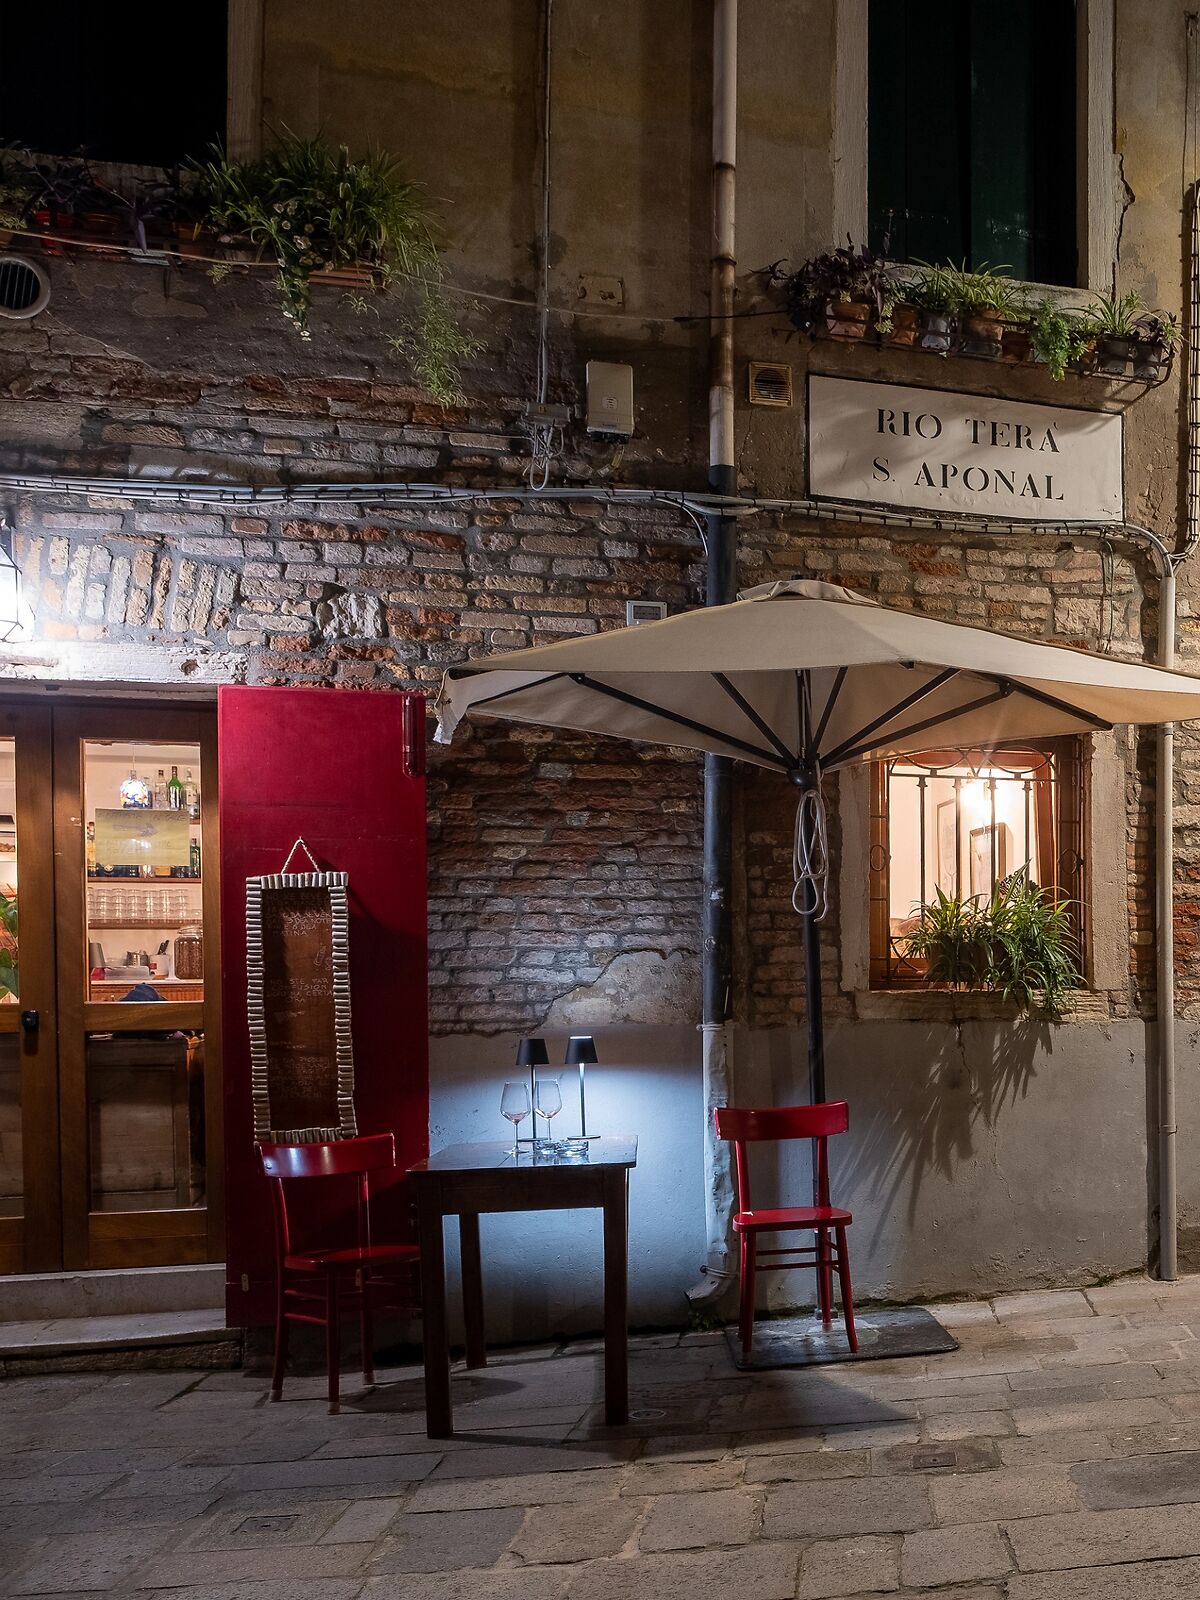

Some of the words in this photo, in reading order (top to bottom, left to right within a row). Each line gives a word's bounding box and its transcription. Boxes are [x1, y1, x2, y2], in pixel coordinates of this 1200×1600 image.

[876, 408, 943, 440] RIO
[872, 456, 897, 483] S.
[914, 461, 1065, 501] APONAL
